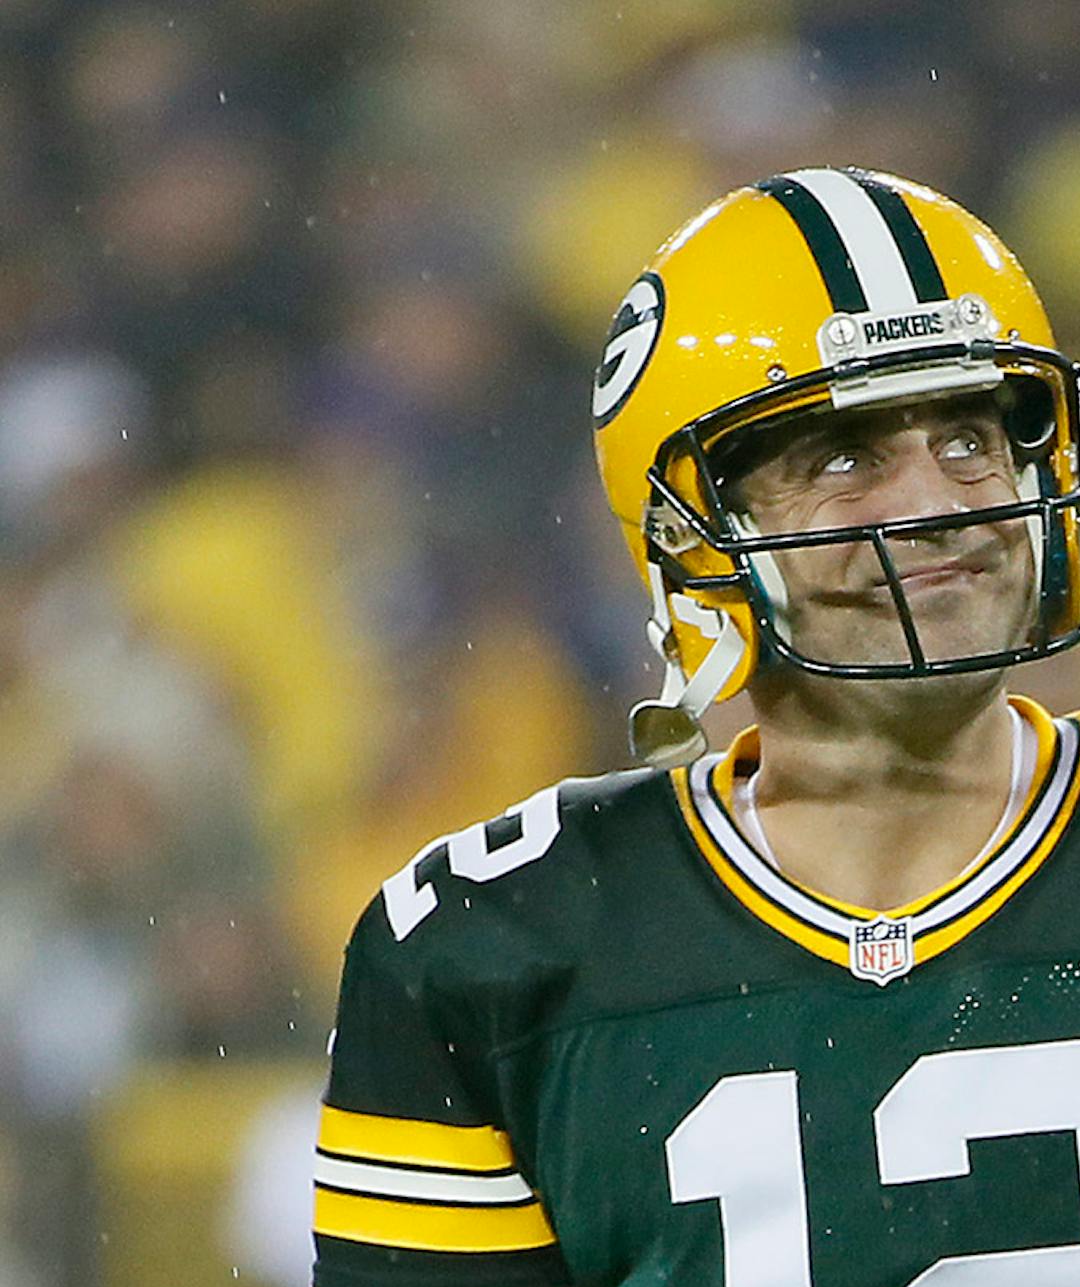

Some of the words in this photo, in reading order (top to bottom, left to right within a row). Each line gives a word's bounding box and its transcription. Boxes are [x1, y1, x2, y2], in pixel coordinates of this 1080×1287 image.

[864, 312, 944, 344] PACKERS
[593, 281, 659, 417] G
[861, 942, 903, 971] NFL
